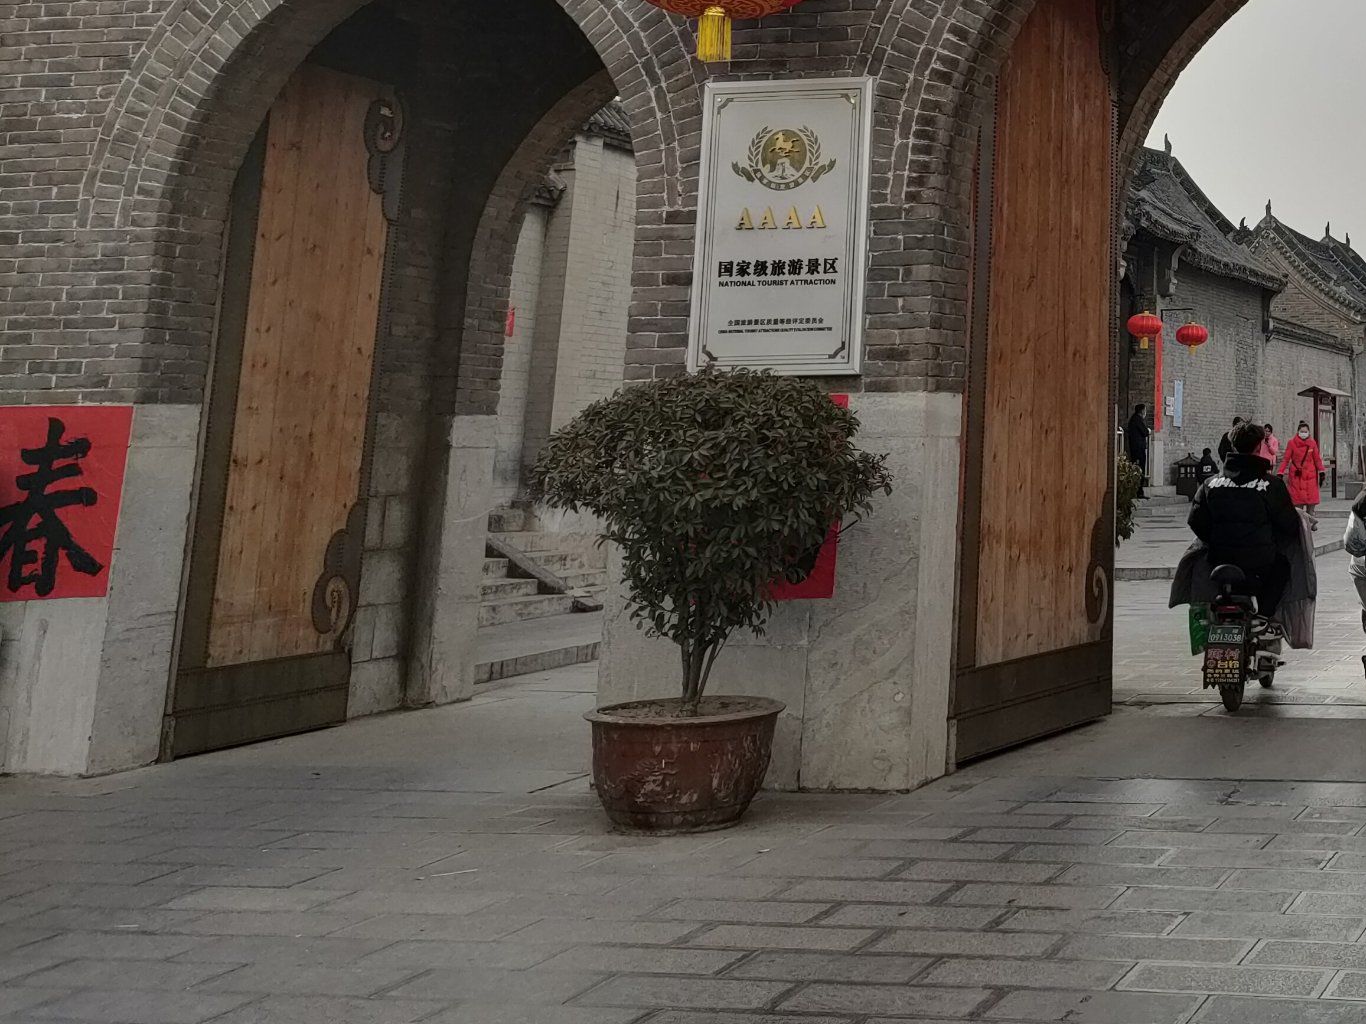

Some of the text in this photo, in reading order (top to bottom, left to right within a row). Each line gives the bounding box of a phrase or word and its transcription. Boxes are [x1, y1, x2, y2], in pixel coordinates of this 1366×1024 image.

[735, 204, 827, 231] AAAA
[717, 257, 839, 279] 国家级旅游景区
[718, 278, 836, 288] NATIONAL TOURIST ATTRACTION
[0, 417, 104, 596] 春
